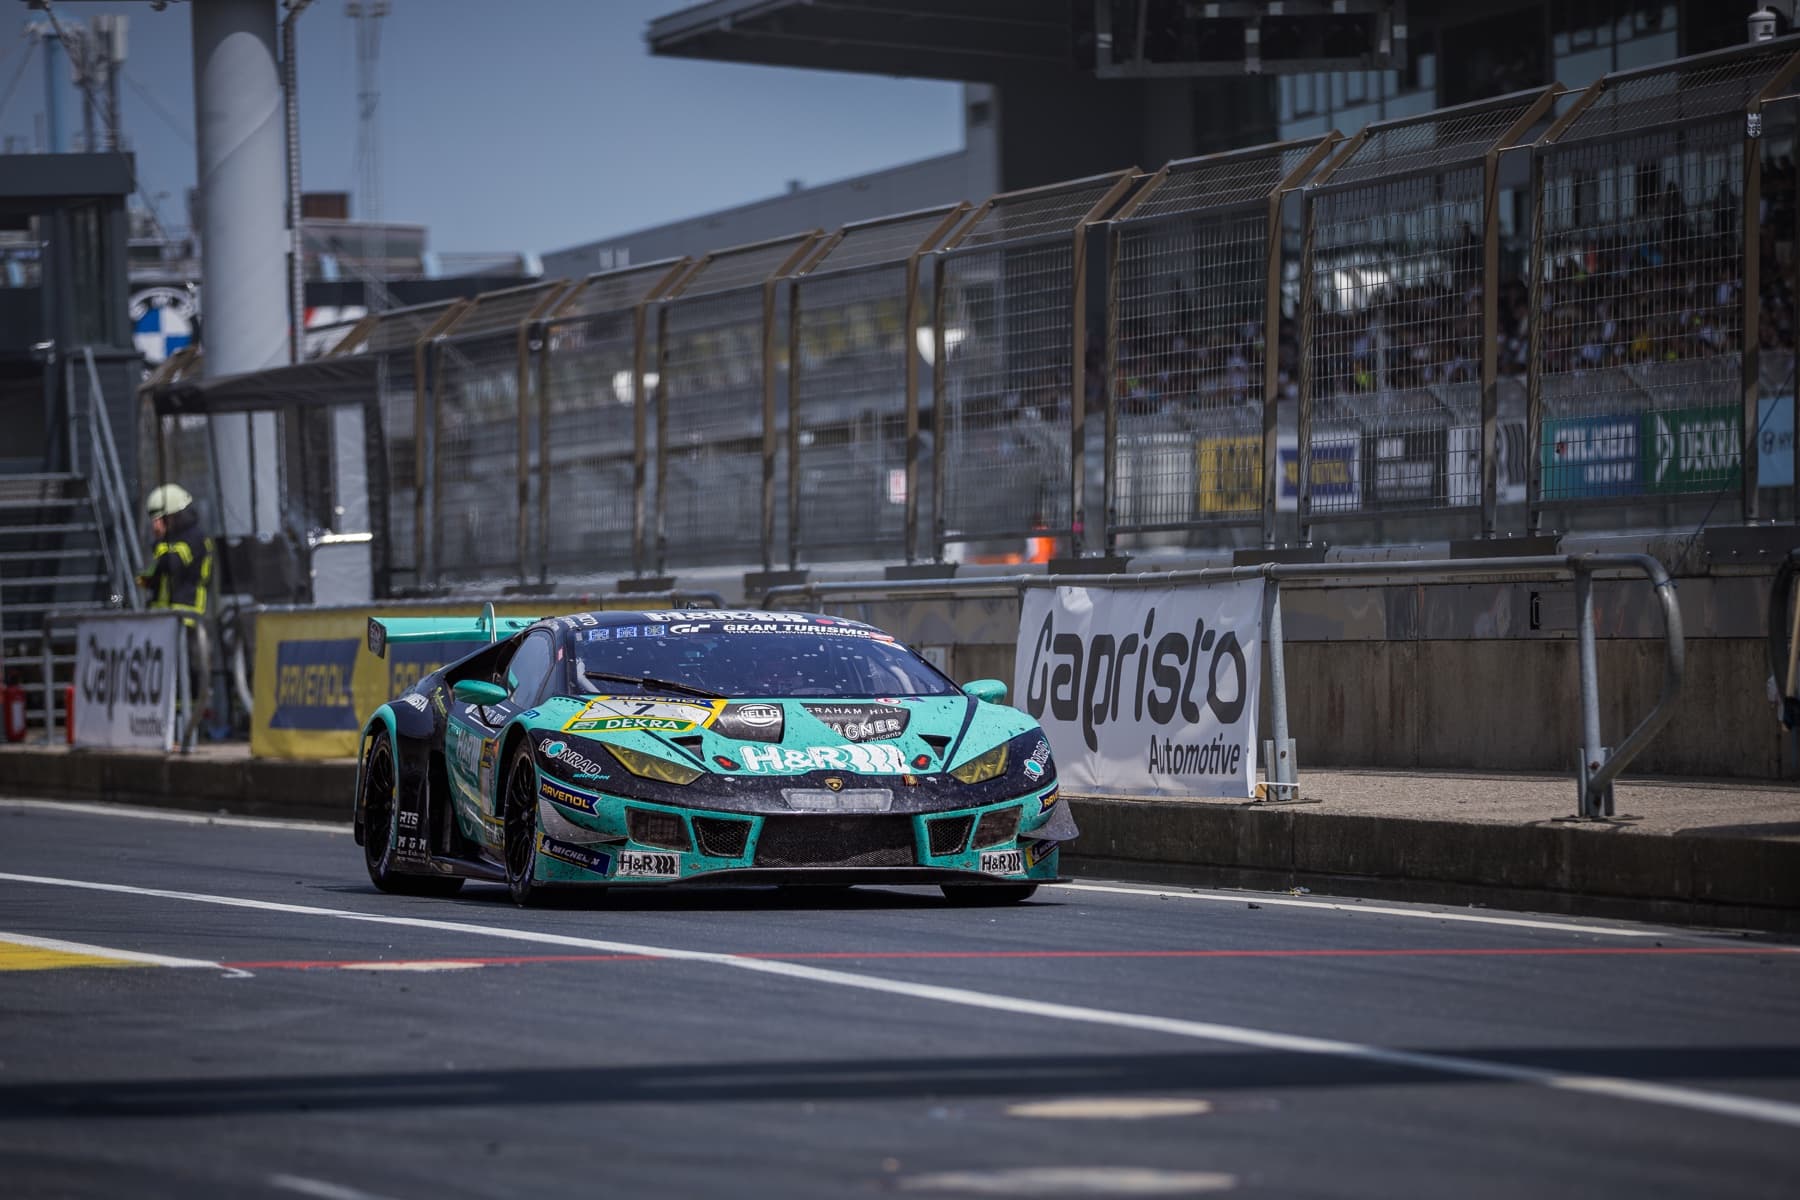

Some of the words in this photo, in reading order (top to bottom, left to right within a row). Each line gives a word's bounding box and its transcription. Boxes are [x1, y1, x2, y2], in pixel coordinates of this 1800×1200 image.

[783, 625, 870, 636] TURISMO
[1027, 608, 1247, 752] Capristo
[633, 703, 655, 715] 7
[741, 709, 780, 718] HELLA
[870, 707, 902, 715] HILL
[606, 719, 679, 730] DEKRA
[825, 719, 900, 740] AGNER
[539, 738, 601, 776] KONRAD
[740, 746, 847, 772] H&R
[1149, 733, 1240, 775] Automotive
[542, 783, 590, 809] RAVENOL
[399, 811, 419, 825] RTS
[619, 854, 652, 871] H&R
[982, 855, 1006, 871] H&R
